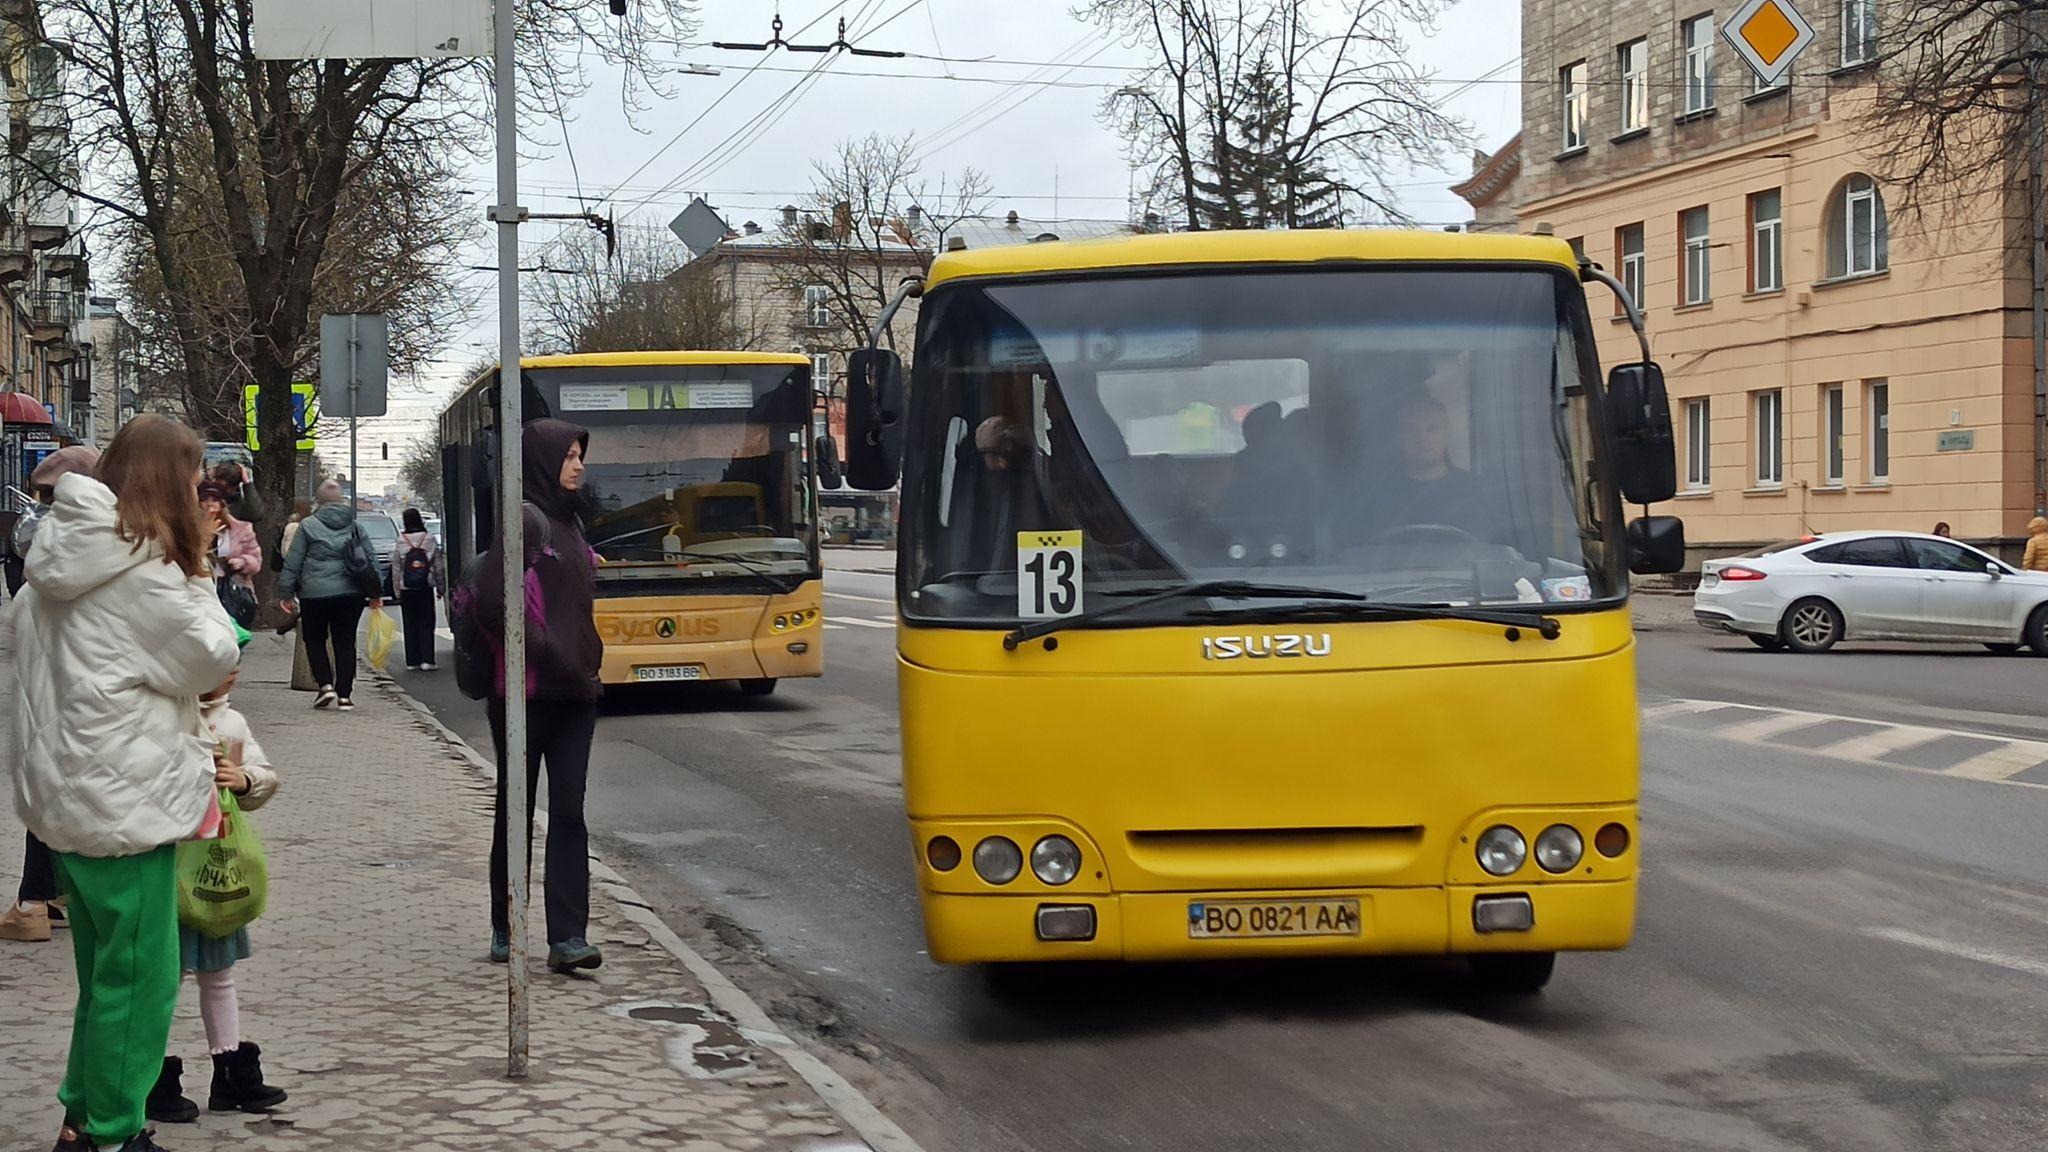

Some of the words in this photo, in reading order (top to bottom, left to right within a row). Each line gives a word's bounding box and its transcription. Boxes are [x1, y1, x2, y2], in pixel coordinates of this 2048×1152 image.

[1025, 550, 1076, 614] 13
[1203, 634, 1331, 660] ISUZU
[1206, 907, 1242, 932] BO
[1250, 906, 1307, 931] 0821
[1316, 904, 1350, 930] AA
